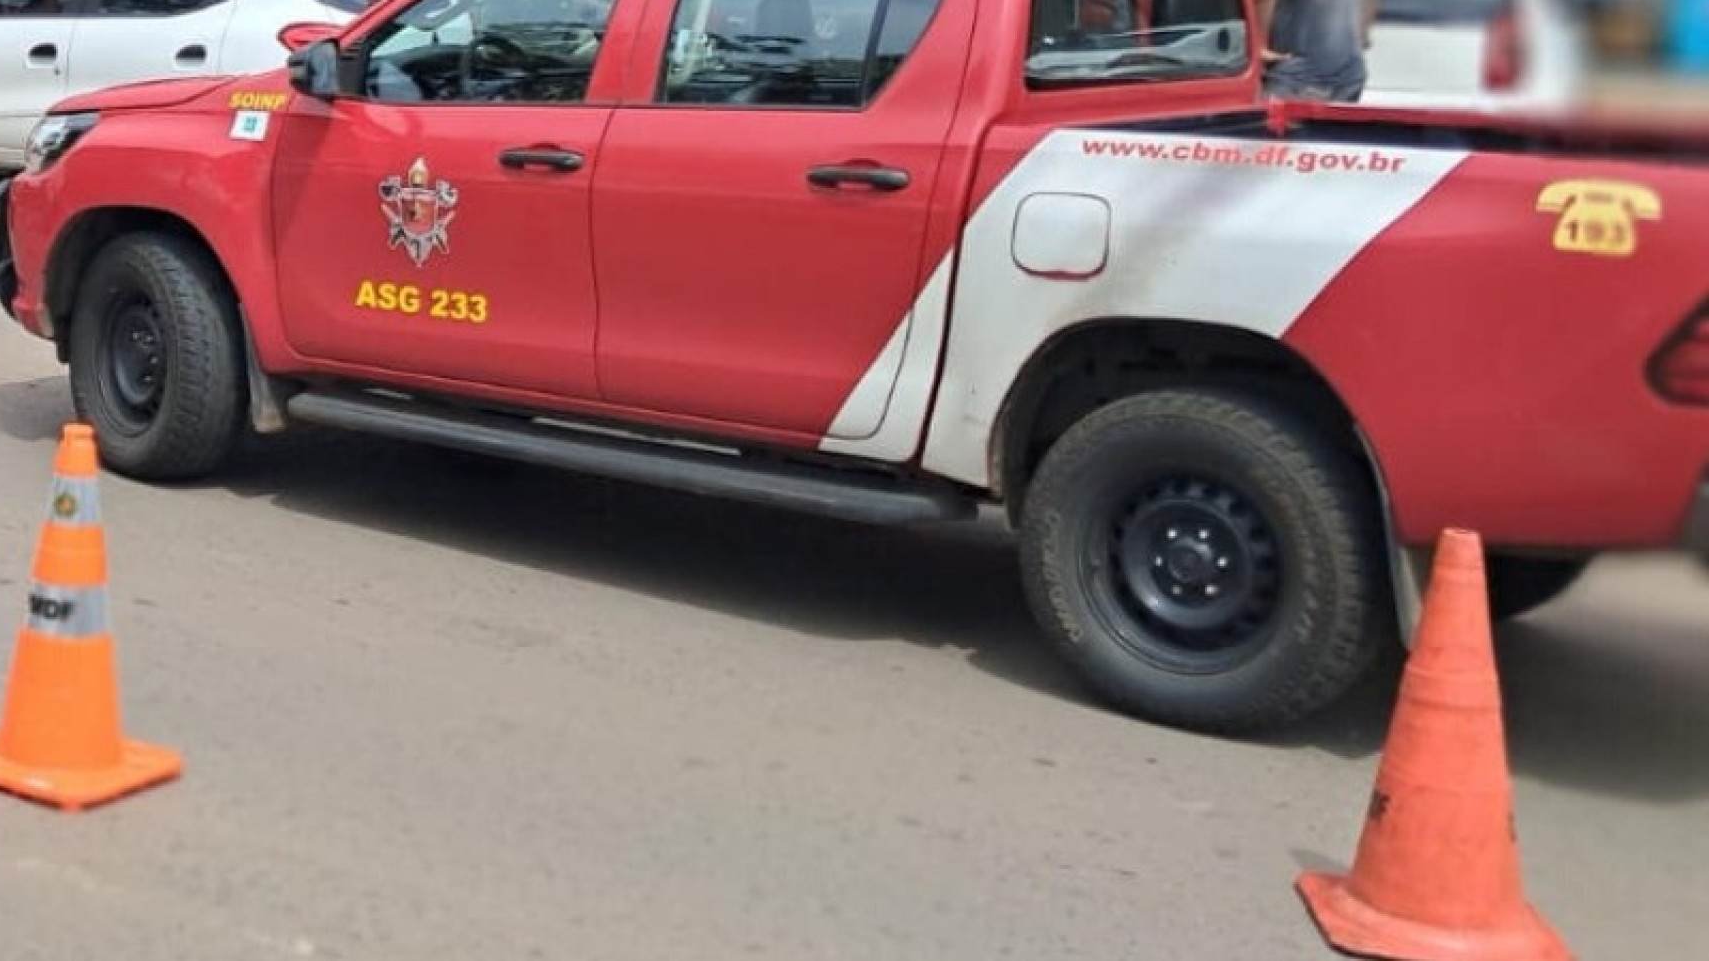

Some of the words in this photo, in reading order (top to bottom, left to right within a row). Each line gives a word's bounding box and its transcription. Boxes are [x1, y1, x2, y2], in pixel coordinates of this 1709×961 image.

[1081, 139, 1407, 173] www.cbm.df.gov.br
[1564, 219, 1628, 245] 193
[355, 280, 422, 314] ASG
[428, 288, 489, 323] 233
